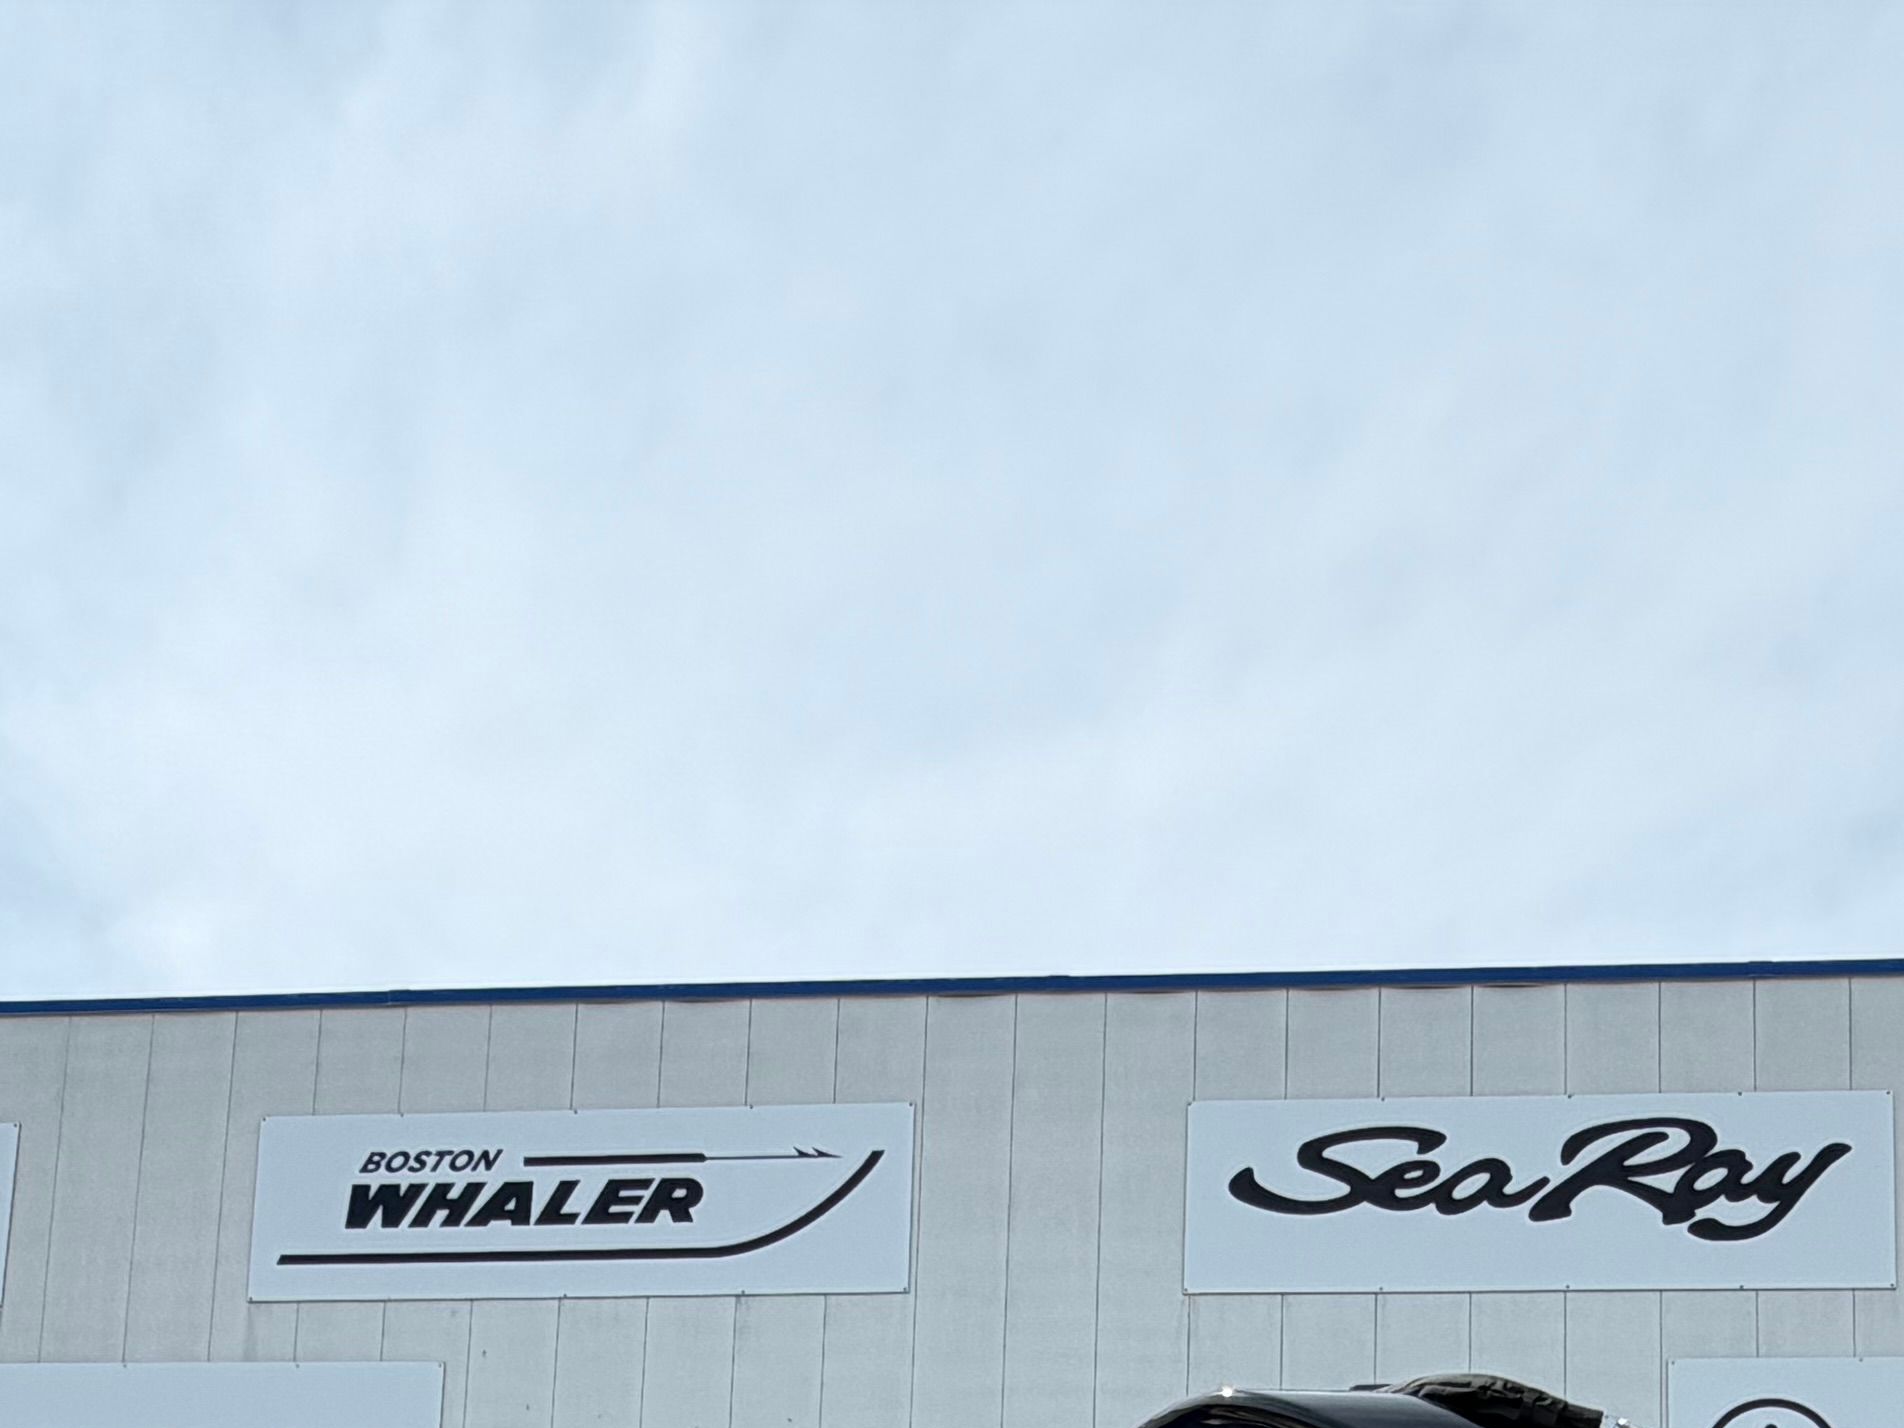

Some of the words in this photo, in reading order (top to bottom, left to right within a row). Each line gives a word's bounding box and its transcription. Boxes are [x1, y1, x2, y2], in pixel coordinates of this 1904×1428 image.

[359, 1149, 503, 1174] BOSTON
[1228, 1125, 1551, 1216] Sea
[1528, 1117, 1852, 1242] Ray
[345, 1177, 704, 1229] WHALER
